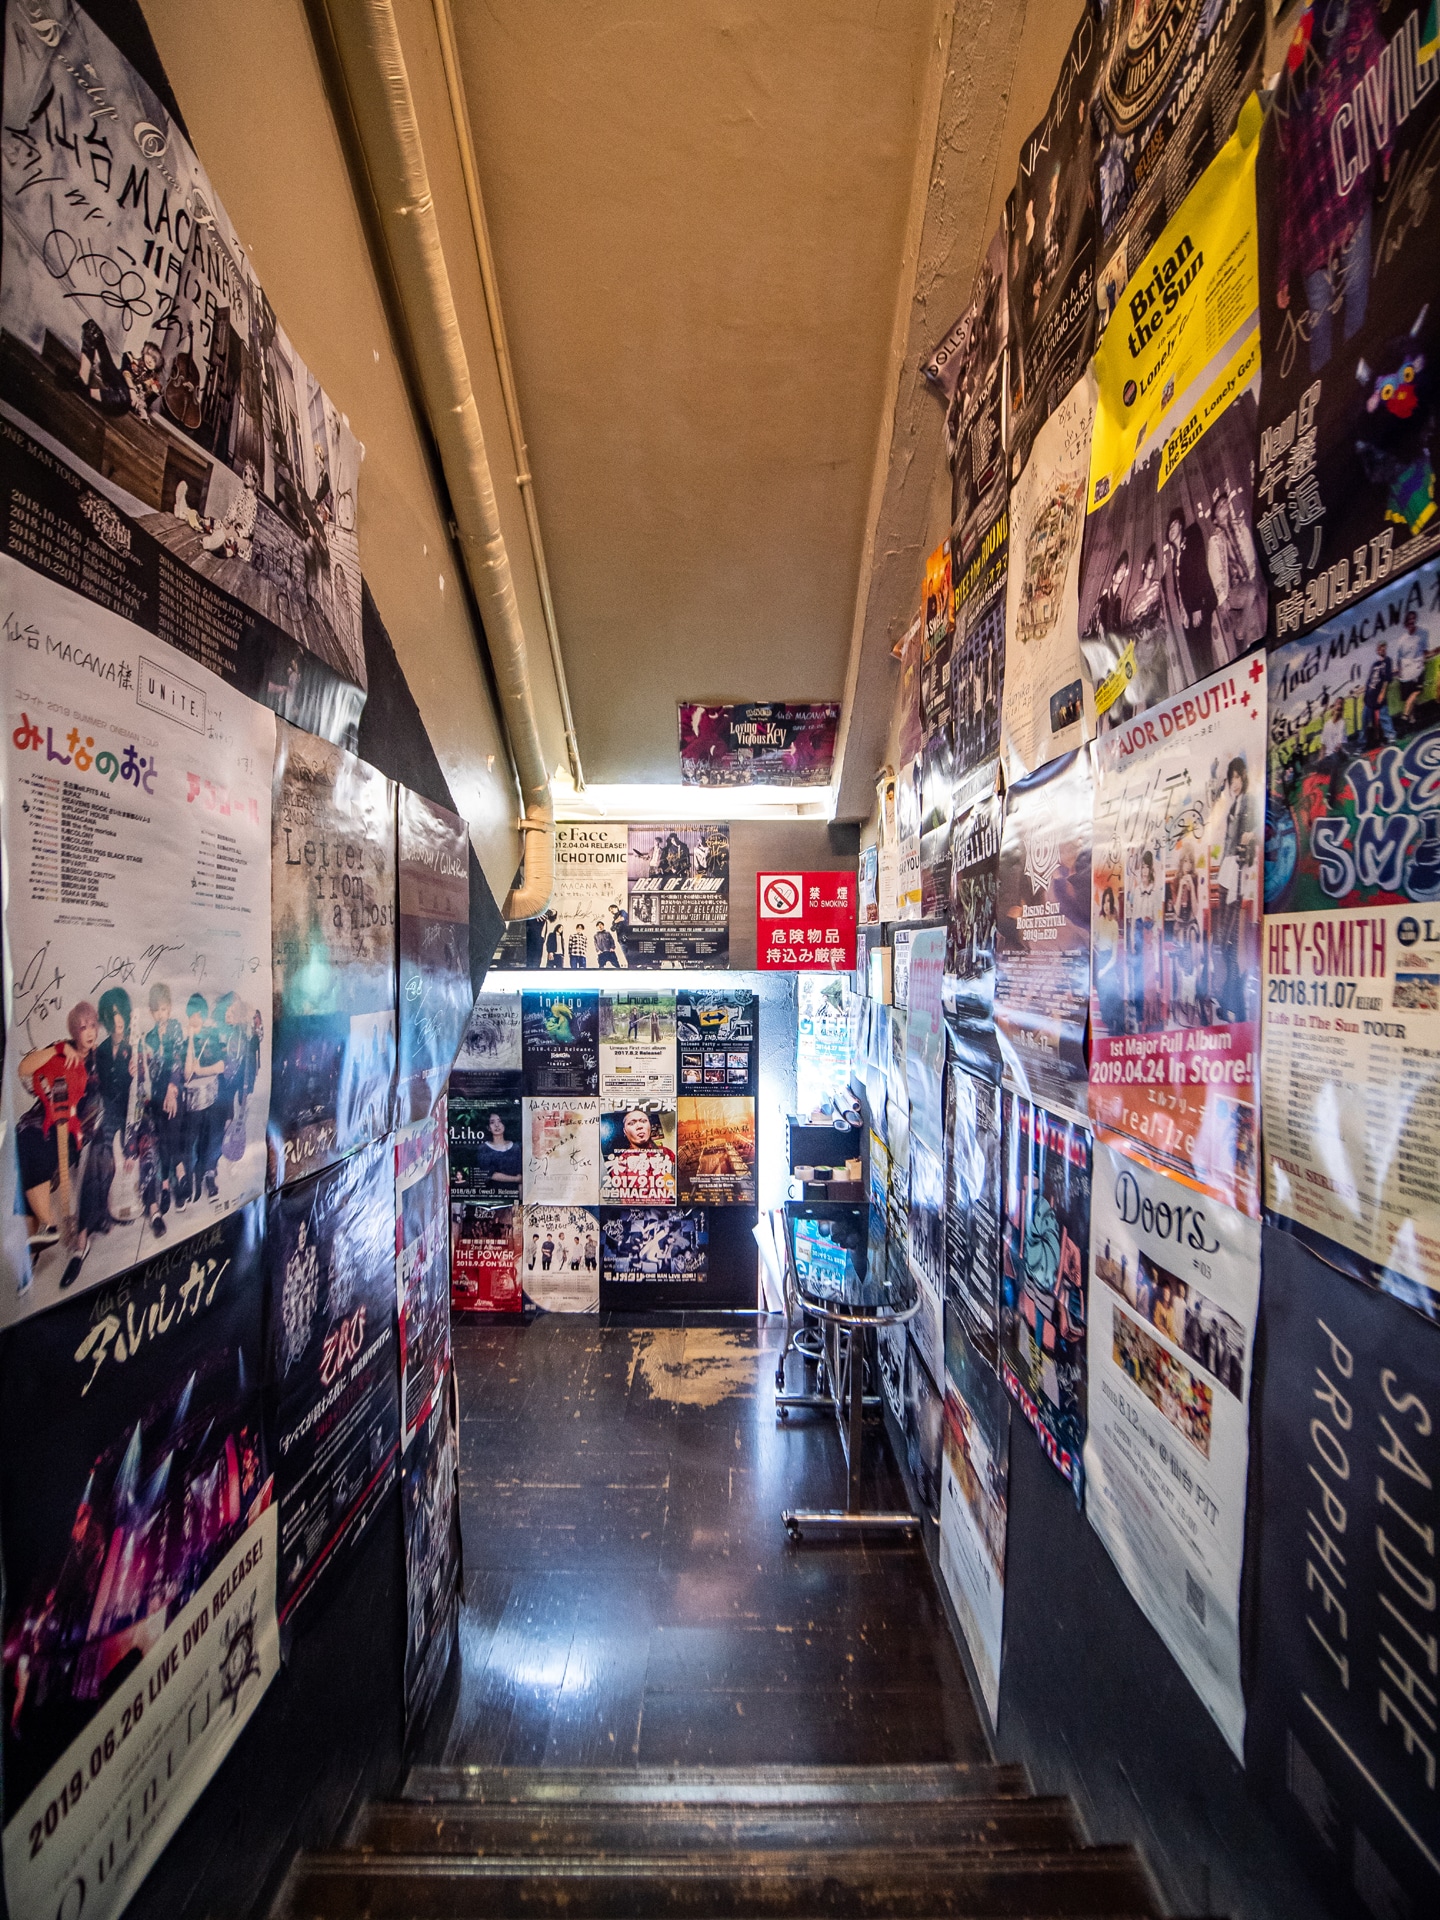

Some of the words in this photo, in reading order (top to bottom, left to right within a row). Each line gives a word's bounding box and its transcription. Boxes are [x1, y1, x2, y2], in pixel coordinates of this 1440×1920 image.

[1128, 234, 1195, 328] Brian
[1068, 280, 1094, 323] COAST
[1126, 308, 1165, 359] the
[1163, 250, 1205, 316] Sun
[926, 326, 967, 378] DOLLS
[1138, 337, 1176, 397] Lonely
[1164, 450, 1181, 478] the
[1179, 421, 1204, 456] Sun
[1204, 376, 1237, 420] Lonely
[1236, 350, 1256, 384] Go!
[1167, 413, 1199, 458] Brian
[981, 513, 1008, 564] ROUND
[1158, 678, 1237, 738] DEBUT!!
[729, 721, 757, 736] Loving
[736, 733, 767, 747] Vicious
[766, 721, 788, 748] Key
[12, 712, 159, 796] みんなのおと
[555, 852, 628, 864] ICHOTOMIC
[560, 882, 599, 891] MACANA
[631, 877, 663, 892] DEAL
[663, 877, 682, 892] OF
[680, 876, 726, 892] CLOWN
[809, 886, 849, 900] 禁煙
[660, 905, 692, 915] 2015.12.2
[693, 905, 729, 914] RELEASE!!
[809, 900, 819, 908] NO
[820, 900, 849, 908] SMOKING
[1022, 903, 1045, 918] RISING
[1044, 901, 1061, 915] SUN
[1016, 915, 1034, 930] ROCK
[1033, 914, 1067, 929] FESTIVAL
[1022, 929, 1038, 942] 2019
[771, 928, 841, 945] 危険物品
[1268, 918, 1387, 978] HEY-SMITH
[766, 947, 847, 964] 持込み厳禁
[539, 995, 582, 1009] Indigo
[1268, 979, 1358, 1010] 2018.11.07
[1266, 1011, 1291, 1026] Life
[1293, 1013, 1307, 1028] In
[1309, 1015, 1332, 1031] The
[1334, 1018, 1360, 1034] Sun
[1362, 1020, 1407, 1040] TOUR
[1109, 1040, 1124, 1058] 1st
[1124, 1038, 1159, 1059] Major
[1159, 1031, 1183, 1054] Full
[1185, 1030, 1232, 1052] Album
[1091, 1058, 1165, 1084] 2019.04.24
[1168, 1057, 1186, 1083] In
[448, 1126, 485, 1140] Liho
[600, 1187, 676, 1200] 仙台MACANA
[602, 1175, 665, 1189] 2017.9.16
[1115, 1170, 1221, 1254] Doors
[455, 1250, 474, 1260] THE
[477, 1250, 515, 1261] POWER
[456, 1260, 484, 1268] 2018.9.5
[497, 1260, 514, 1268] SALE
[1194, 1486, 1220, 1527] PIT
[1305, 1315, 1354, 1690] PROPHET
[27, 1692, 145, 1864] 2019.06.26
[147, 1650, 182, 1706] LIVE
[181, 1615, 211, 1662] DVD
[211, 1535, 266, 1622] RELEASE!
